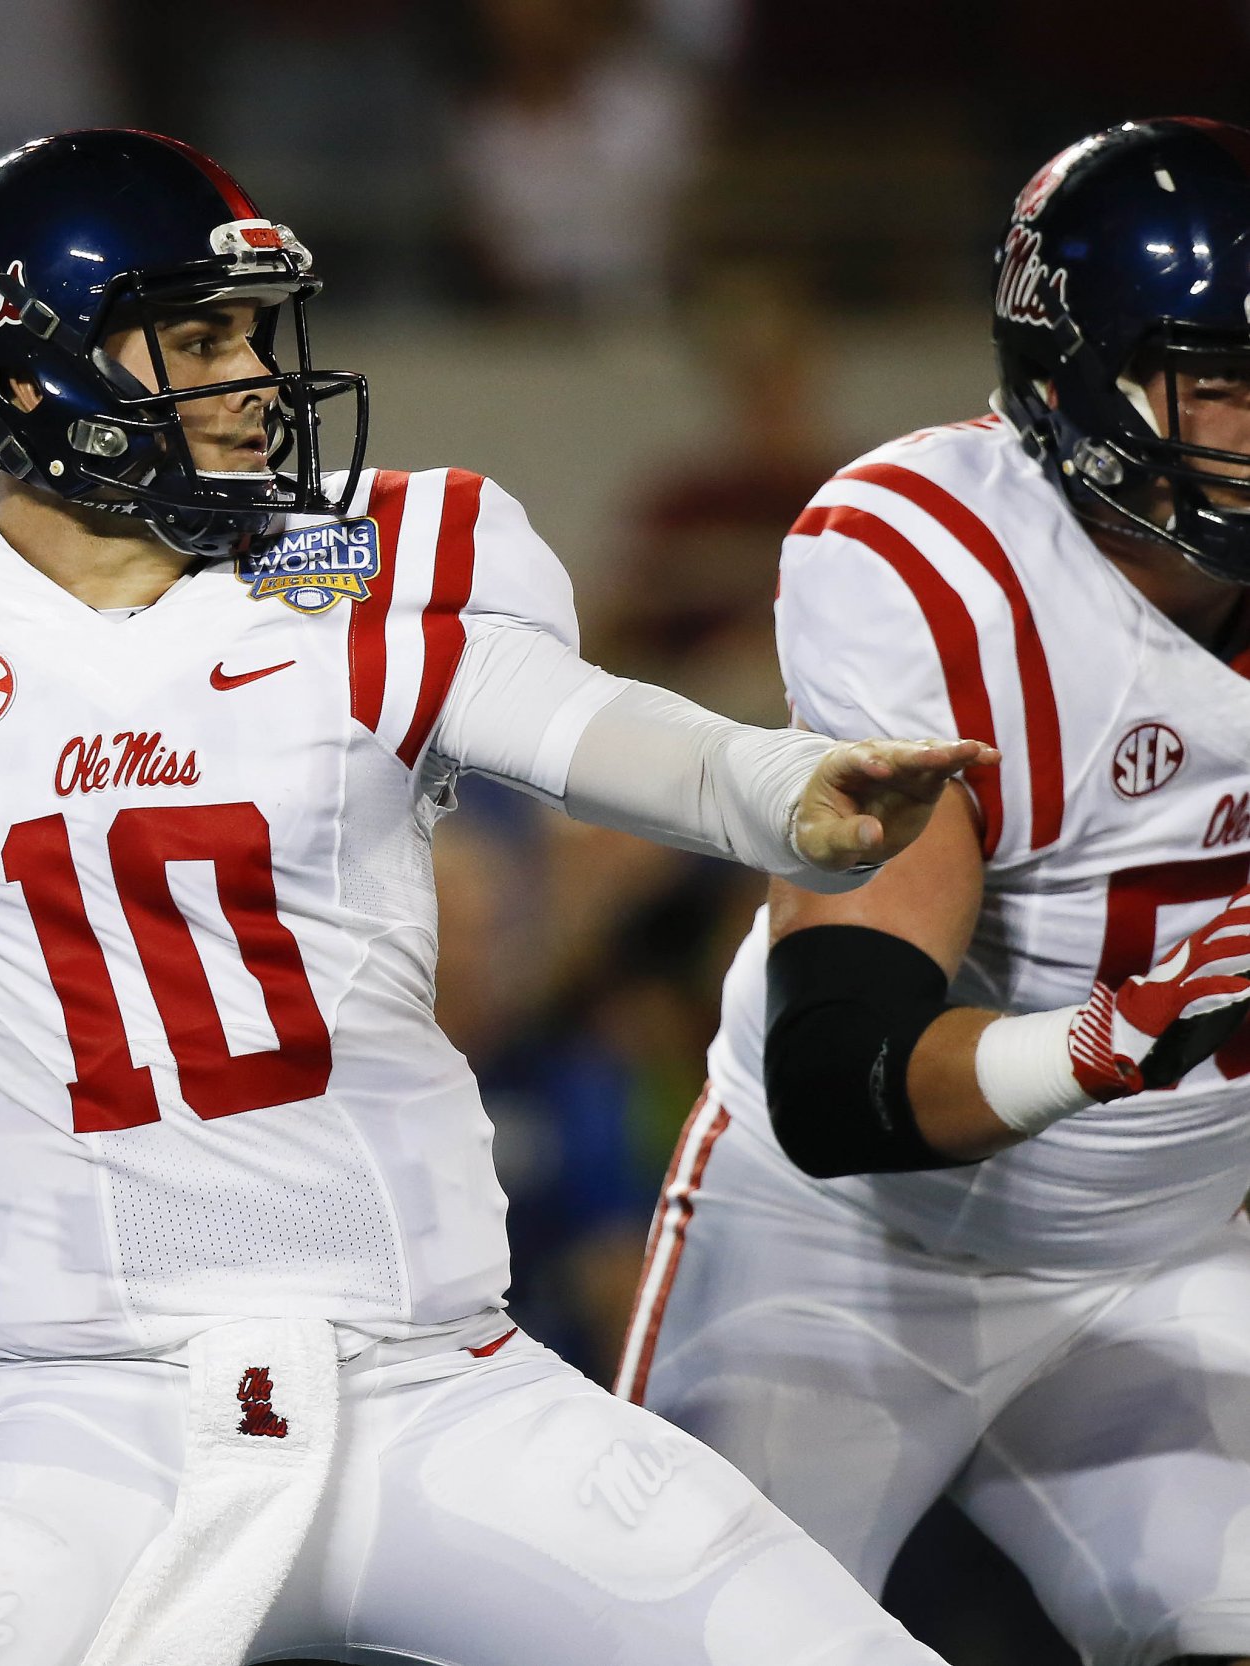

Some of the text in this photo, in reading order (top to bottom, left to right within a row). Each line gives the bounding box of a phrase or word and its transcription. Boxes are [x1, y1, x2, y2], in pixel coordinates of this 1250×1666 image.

[252, 526, 370, 558] AMPING
[266, 576, 353, 588] KICKOFF
[54, 731, 201, 797] Ole Miss
[1114, 725, 1183, 795] SEC
[1, 802, 332, 1133] 10
[236, 1366, 274, 1402] Ole
[236, 1400, 289, 1438] Miss
